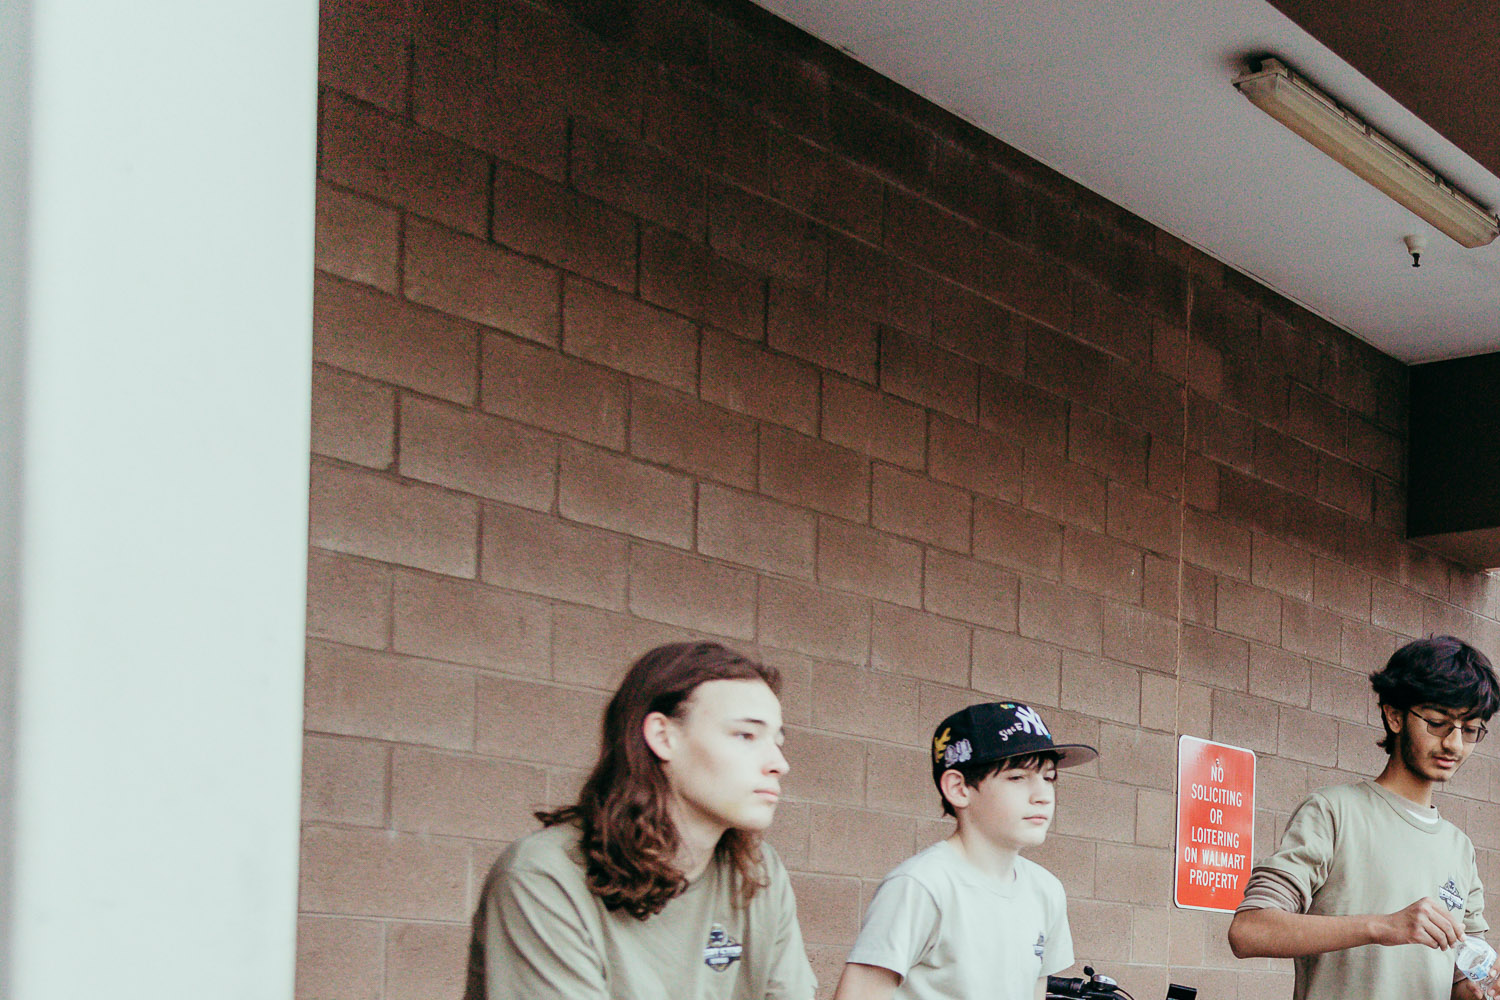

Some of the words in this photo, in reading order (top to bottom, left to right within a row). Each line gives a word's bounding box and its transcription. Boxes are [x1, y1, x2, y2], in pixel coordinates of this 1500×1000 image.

[1211, 766, 1224, 782] NO
[1191, 784, 1242, 807] SOLICITING
[1210, 809, 1222, 824] OR
[1192, 826, 1239, 848] LOITERING
[1185, 847, 1197, 863] ON
[1202, 849, 1245, 870] WALMART
[1190, 869, 1238, 889] PROPERTY
